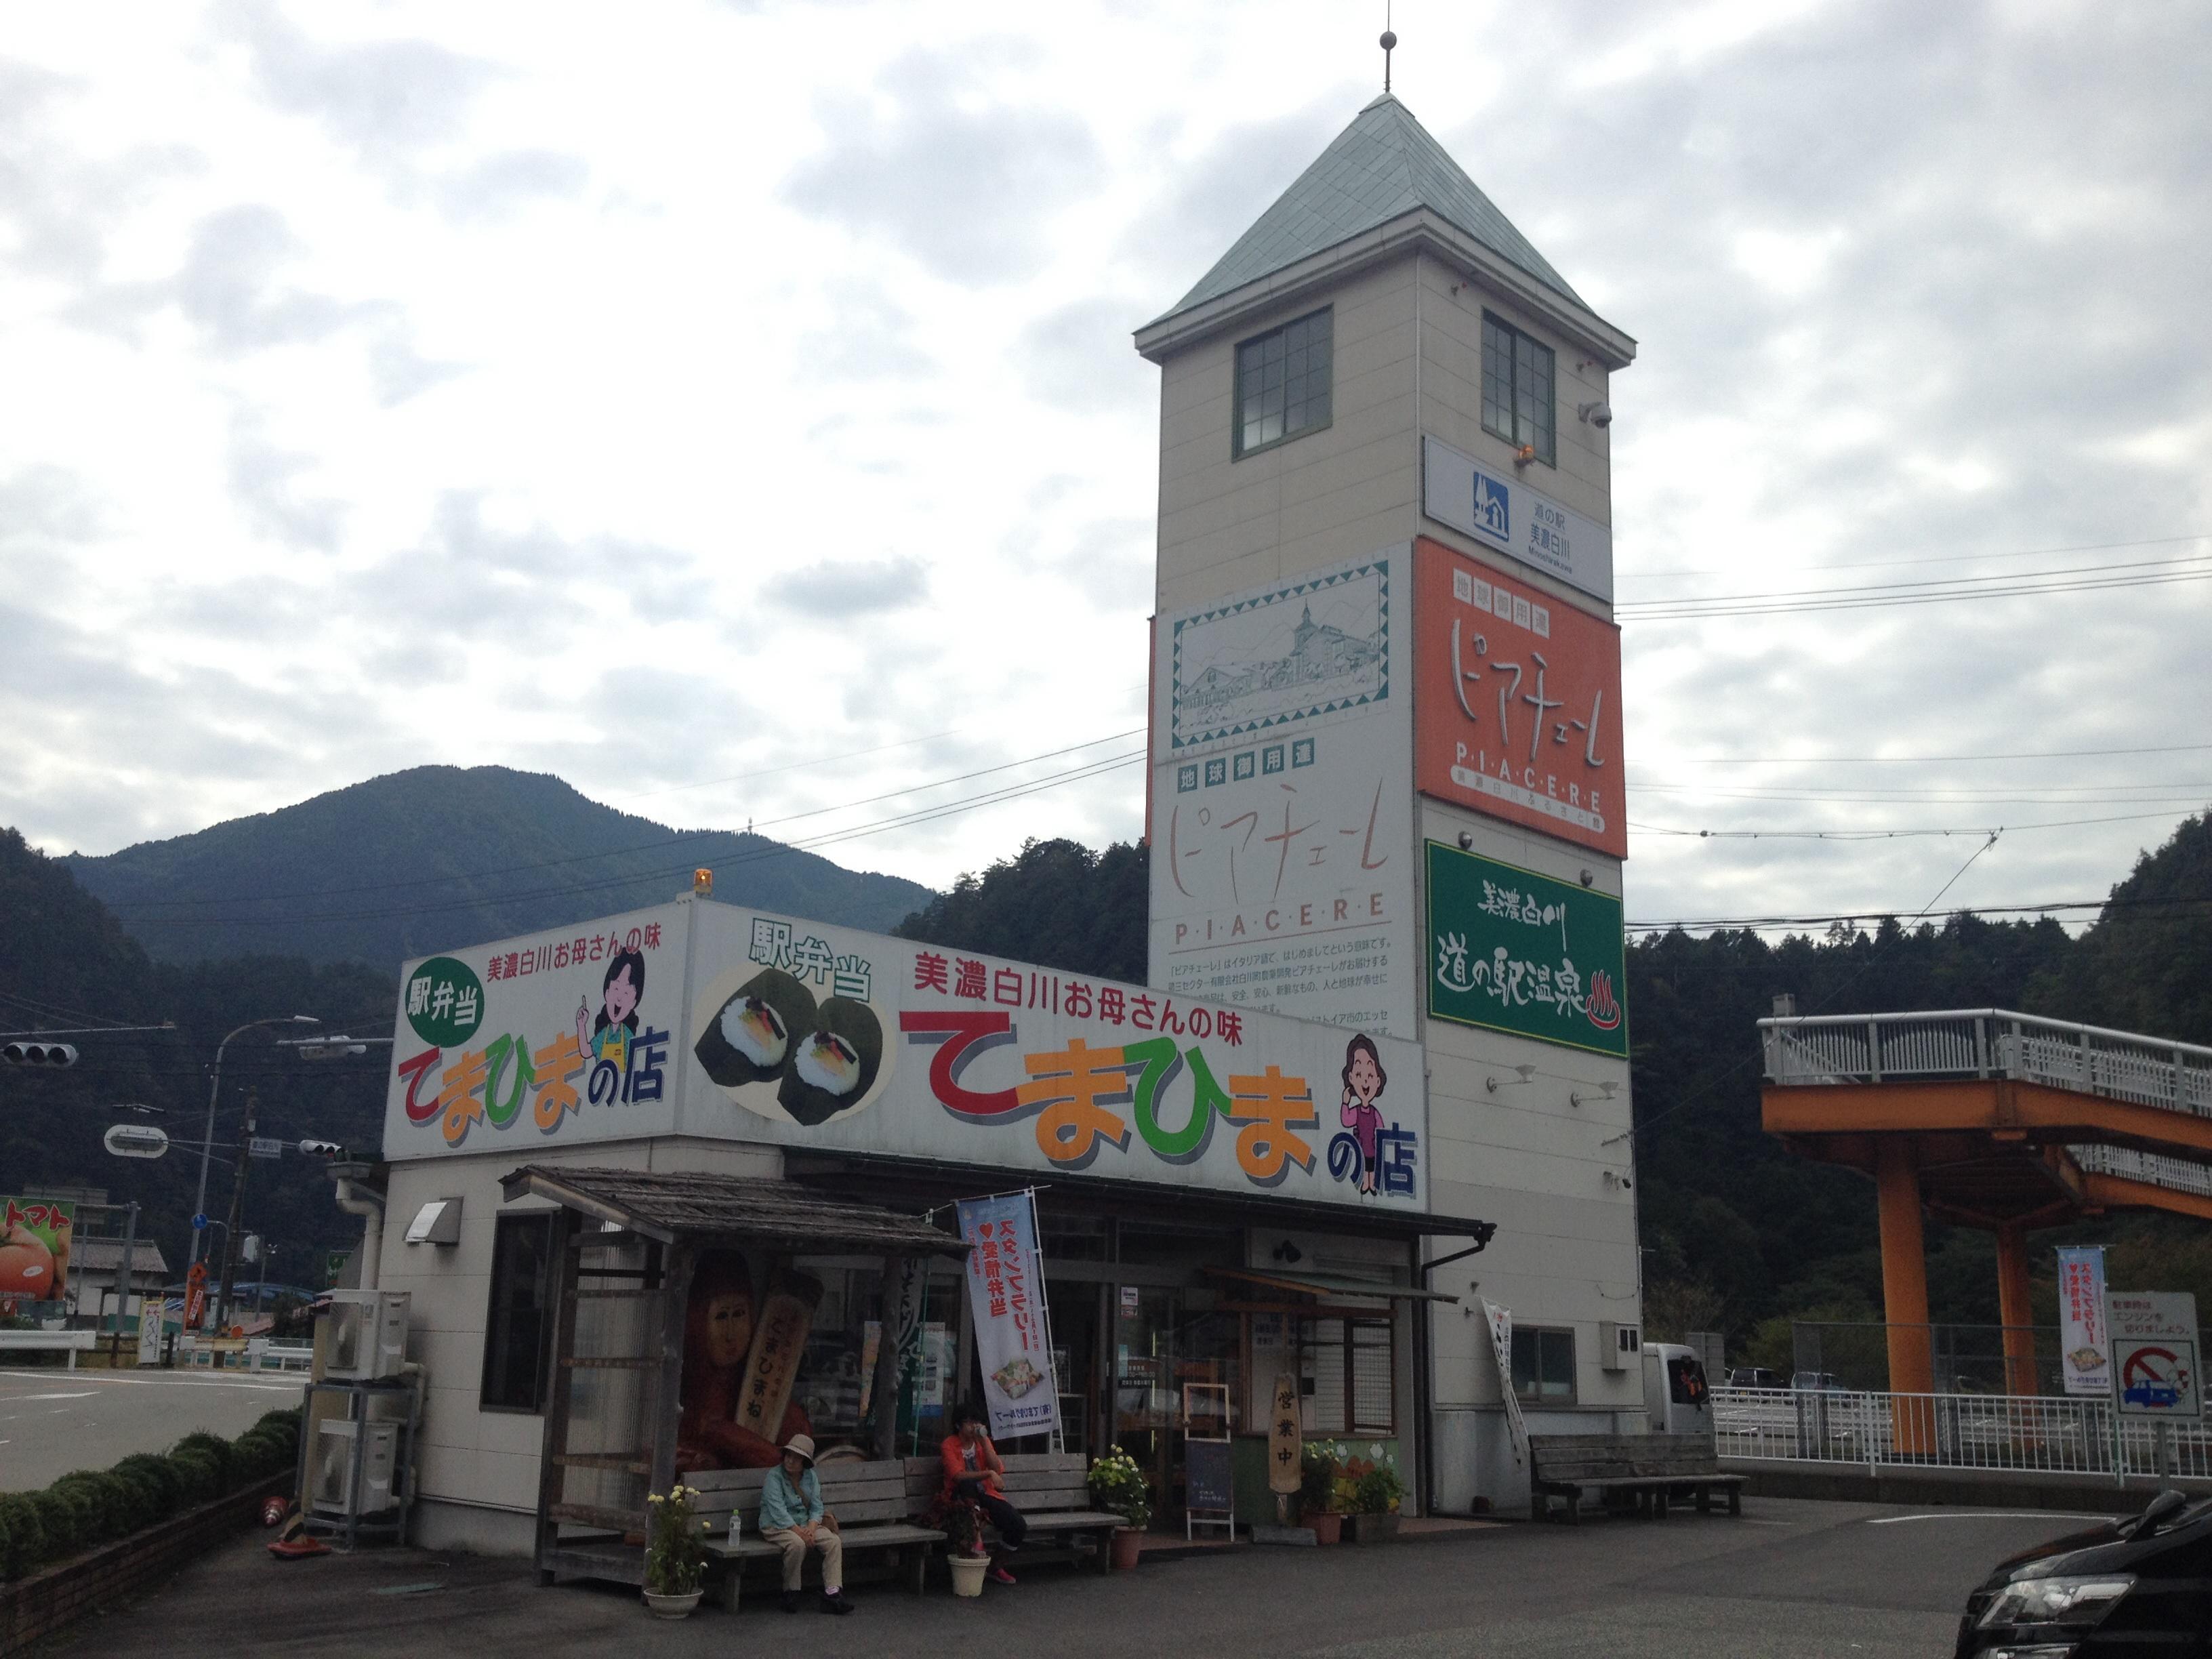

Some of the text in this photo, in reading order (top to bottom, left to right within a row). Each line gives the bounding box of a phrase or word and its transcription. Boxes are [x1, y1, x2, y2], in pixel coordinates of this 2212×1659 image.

[1530, 525, 1570, 560] 美濃白川
[1534, 501, 1565, 530] 道の駅
[1180, 741, 1312, 790] 地球御用達
[487, 922, 661, 982] 美濃白川お母さんの味
[1477, 879, 1567, 952] 美濃白川
[749, 918, 872, 1002] 駅弁当
[1437, 931, 1588, 1017] 道の駅温泉
[407, 976, 478, 1026] 駅弁当
[915, 951, 1244, 1046] 美濃白川お母さんの味
[398, 1026, 670, 1145] てまひまの店
[900, 1010, 1418, 1196] てまひまの店
[5, 1198, 71, 1231] トマト
[1277, 1391, 1294, 1466] 営業中
